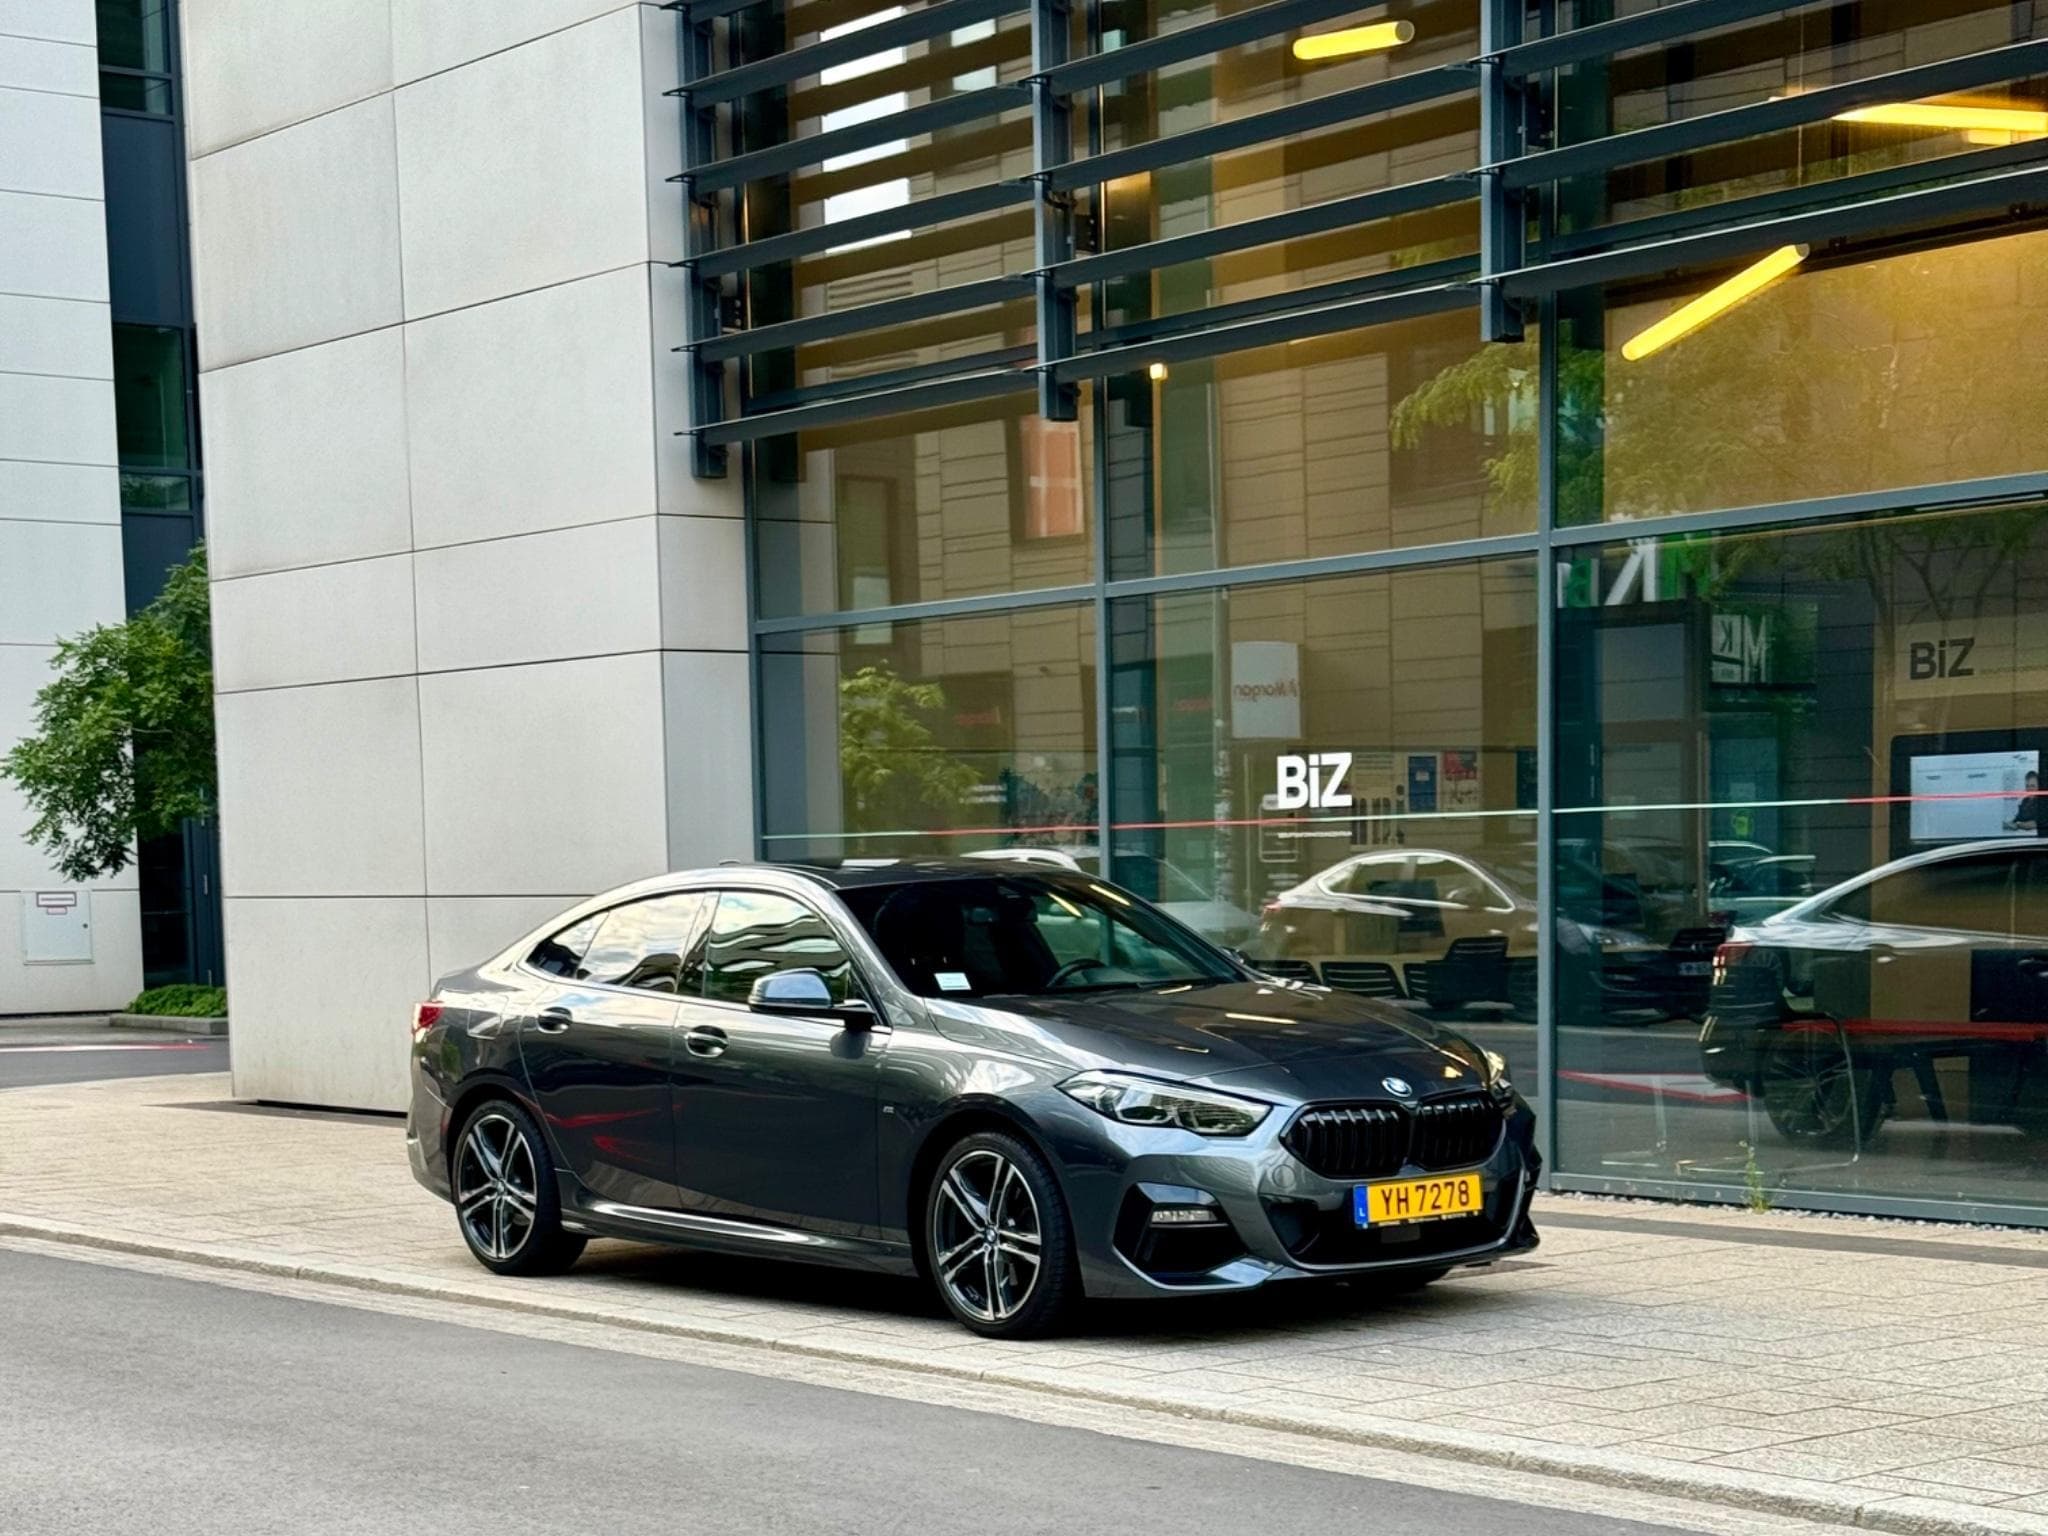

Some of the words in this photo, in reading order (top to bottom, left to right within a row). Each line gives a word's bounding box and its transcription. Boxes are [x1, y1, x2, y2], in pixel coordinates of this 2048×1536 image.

[1910, 637, 1975, 680] BiZ
[1277, 752, 1352, 809] BiZ
[1360, 1208, 1366, 1217] L
[1381, 1187, 1409, 1215] YH
[1415, 1180, 1469, 1212] 7278
